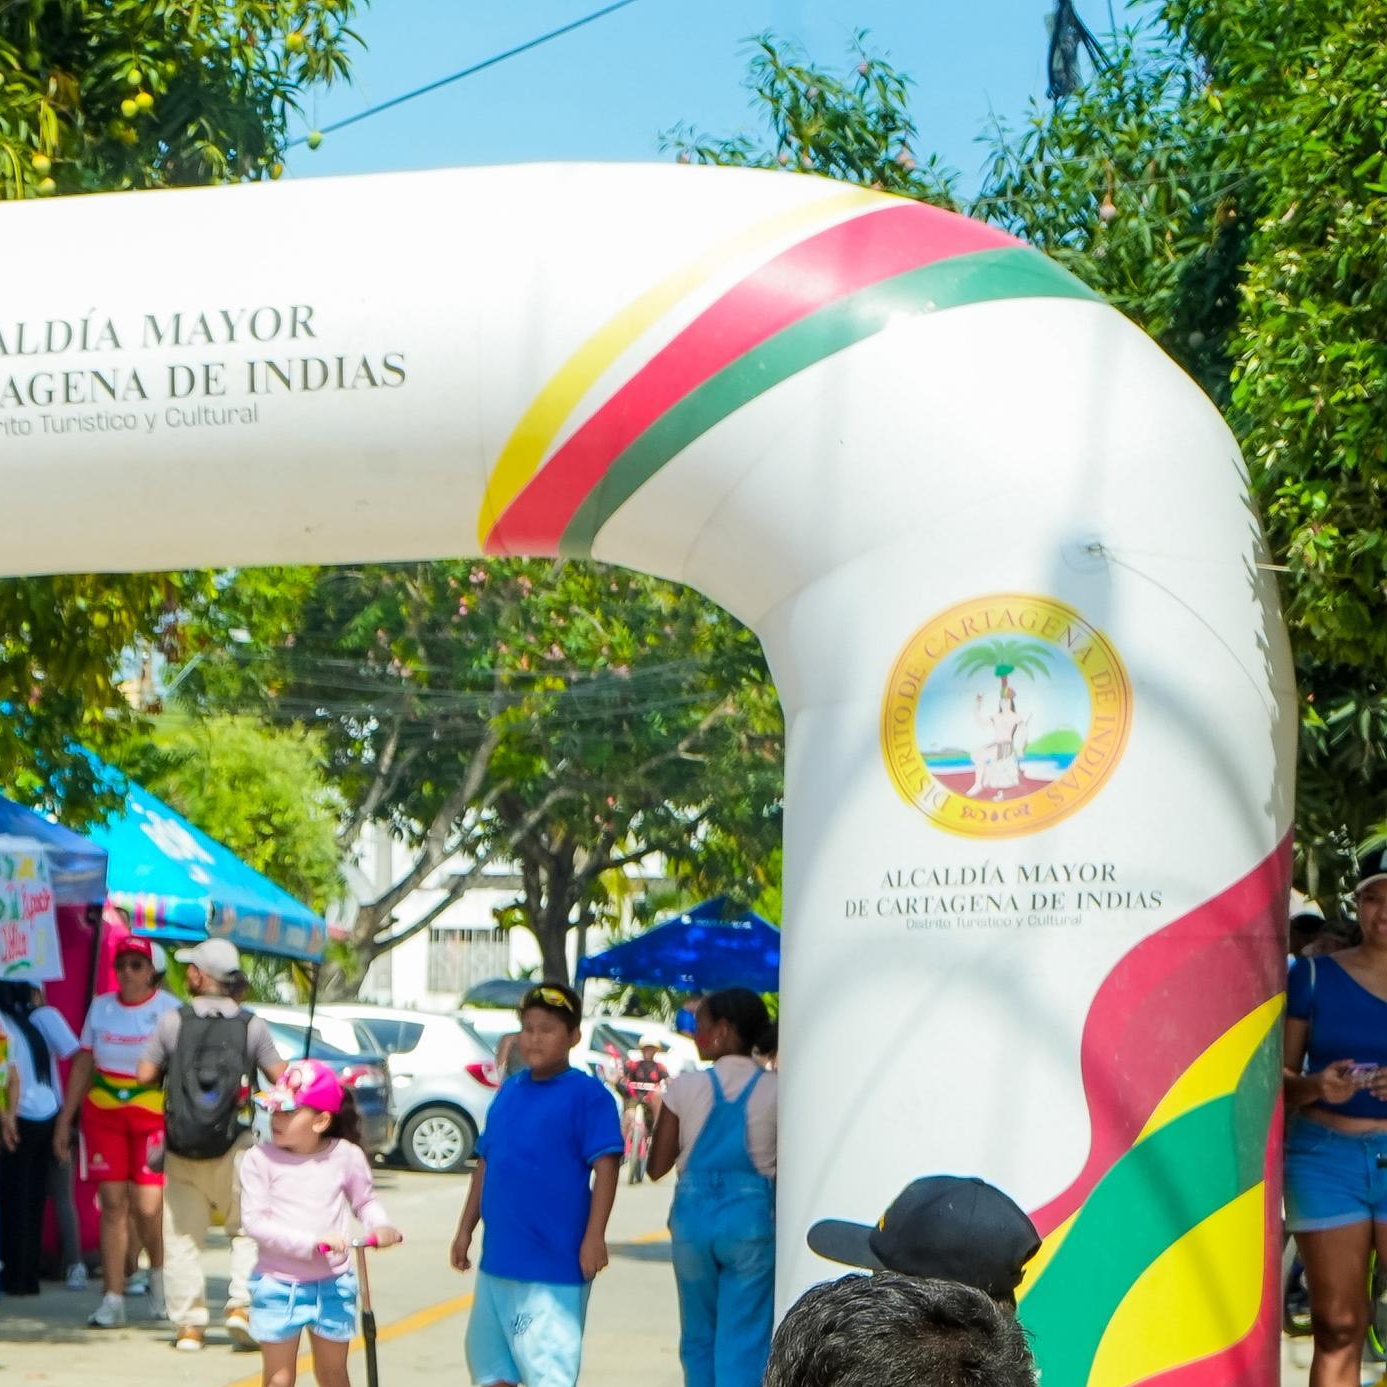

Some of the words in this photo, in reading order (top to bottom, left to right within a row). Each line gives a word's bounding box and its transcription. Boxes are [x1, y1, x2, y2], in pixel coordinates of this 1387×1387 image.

[141, 304, 317, 349] MAYOR
[166, 362, 227, 399] DE
[246, 352, 406, 395] INDIAS
[144, 410, 157, 434] y
[164, 402, 259, 429] Cultural
[923, 607, 1094, 666] CARTAGENA
[900, 667, 926, 702] DE
[1090, 668, 1117, 706] DE
[892, 706, 952, 813] DISTRITO
[1046, 714, 1117, 808] INDIAS
[881, 859, 1005, 888] ALCALDÍA
[1017, 862, 1117, 883] MAYOR
[845, 898, 869, 918] DE
[876, 892, 1019, 916] CARTAGENA
[1031, 891, 1065, 911] DE
[1077, 889, 1163, 910] INDIAS
